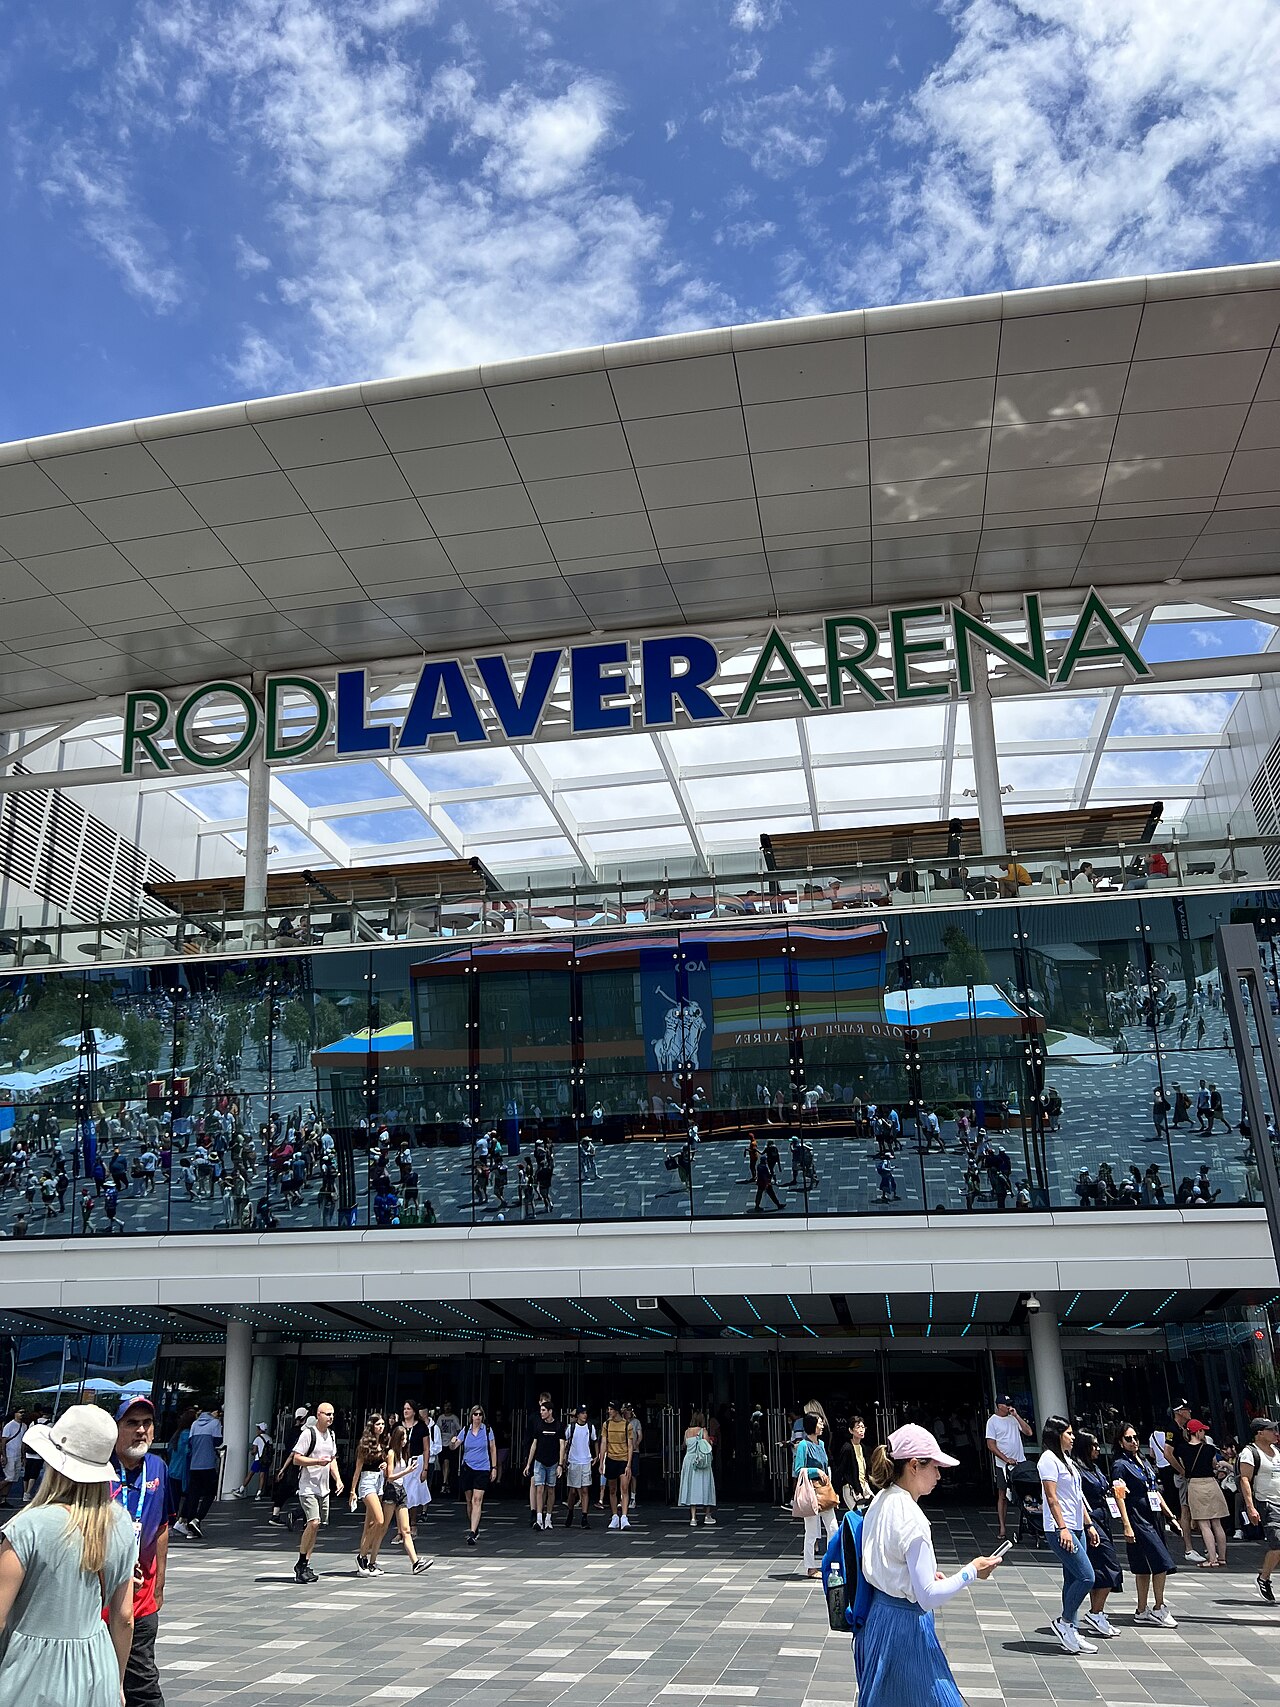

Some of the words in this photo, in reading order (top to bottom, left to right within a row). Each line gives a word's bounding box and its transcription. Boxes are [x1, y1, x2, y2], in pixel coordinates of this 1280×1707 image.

[121, 674, 333, 776] ROD
[335, 633, 731, 759] LAVER
[731, 584, 1154, 719] ARENA
